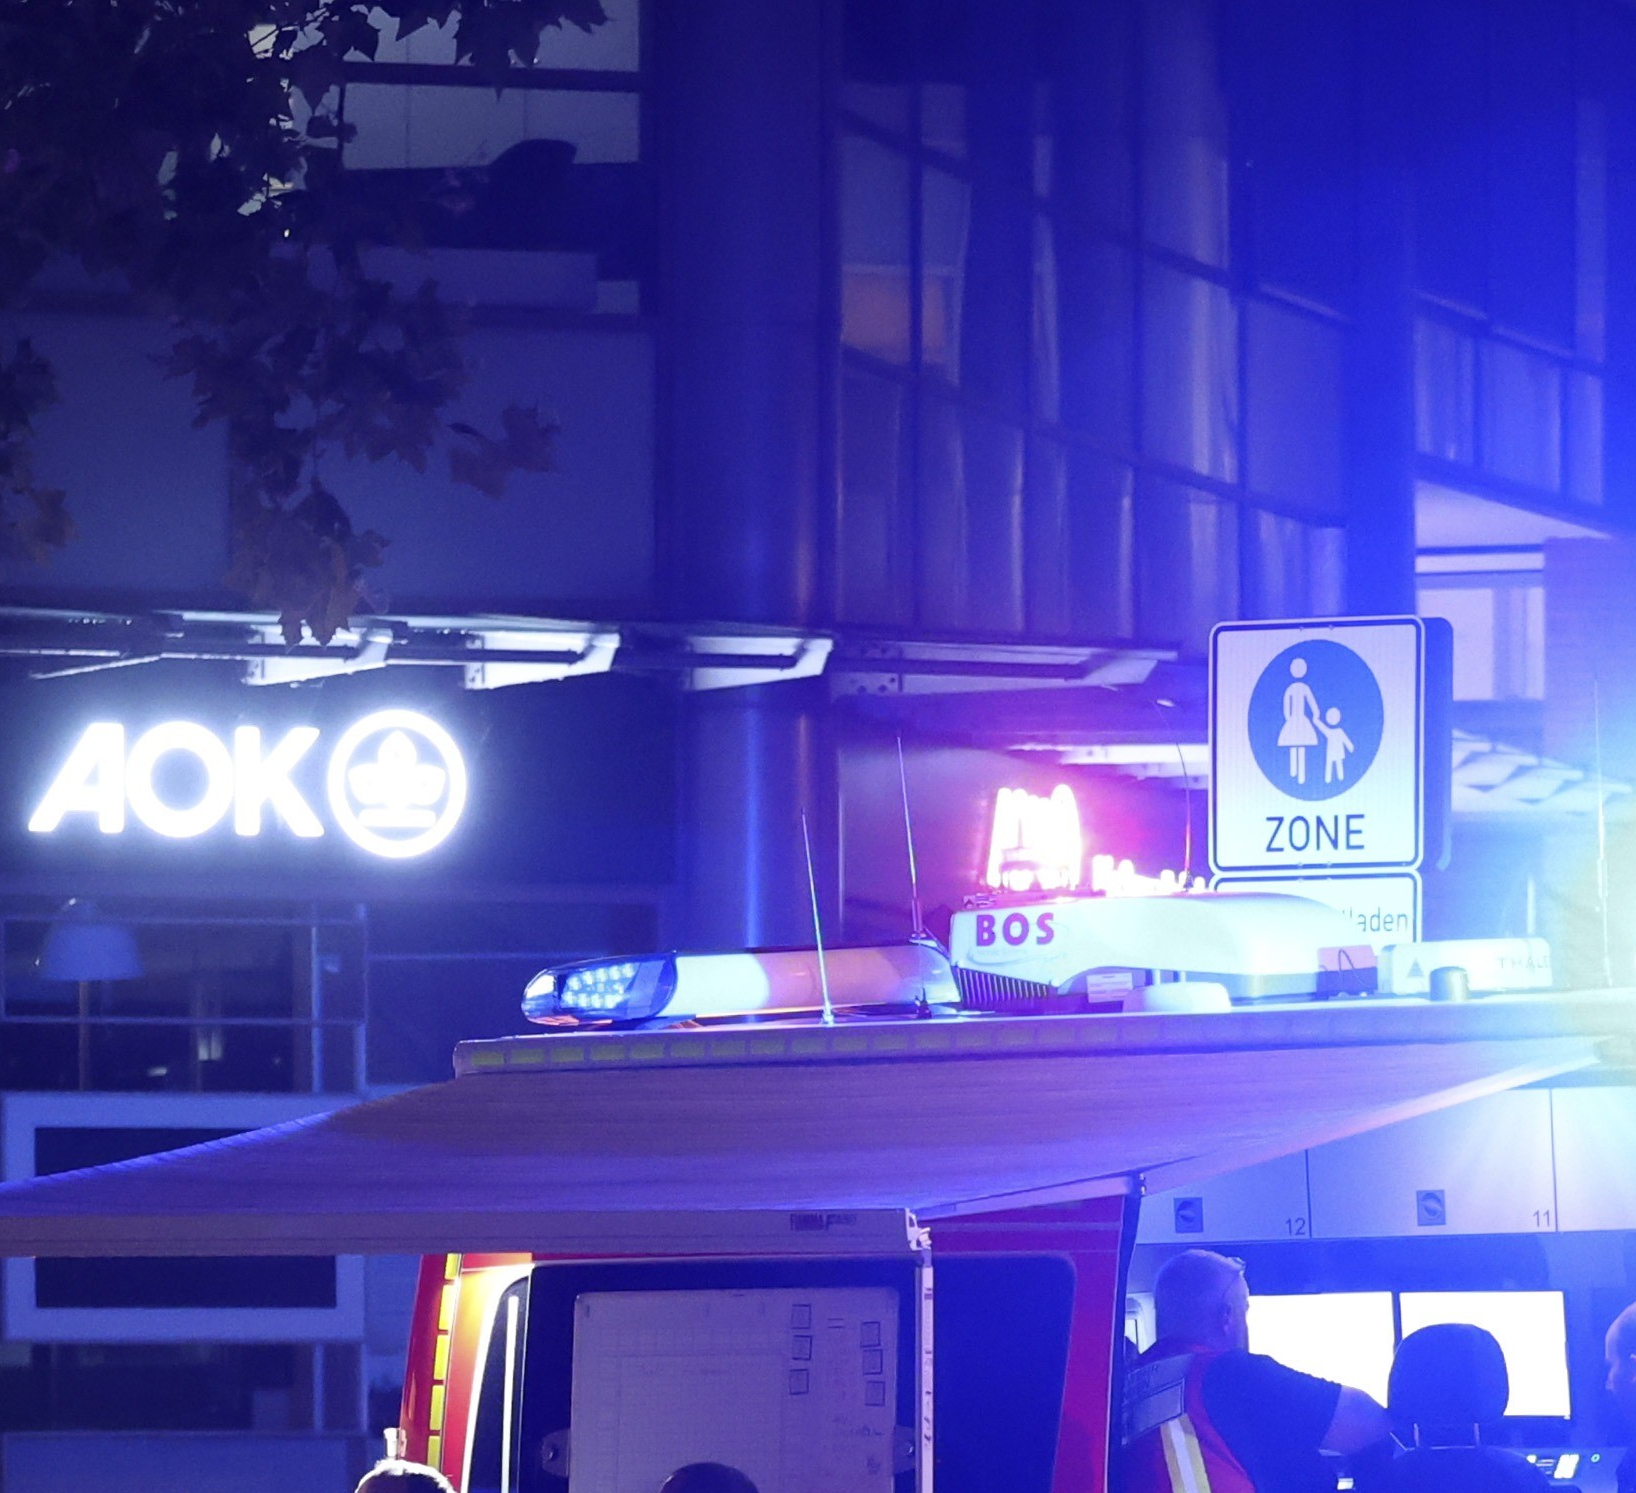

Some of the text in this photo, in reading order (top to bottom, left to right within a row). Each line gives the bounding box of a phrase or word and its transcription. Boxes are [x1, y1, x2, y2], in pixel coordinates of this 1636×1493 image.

[28, 721, 325, 838] AOK
[1265, 814, 1366, 852] ZONE
[976, 912, 1055, 947] BOS
[1285, 1217, 1306, 1236] 12
[1532, 1209, 1552, 1228] 11
